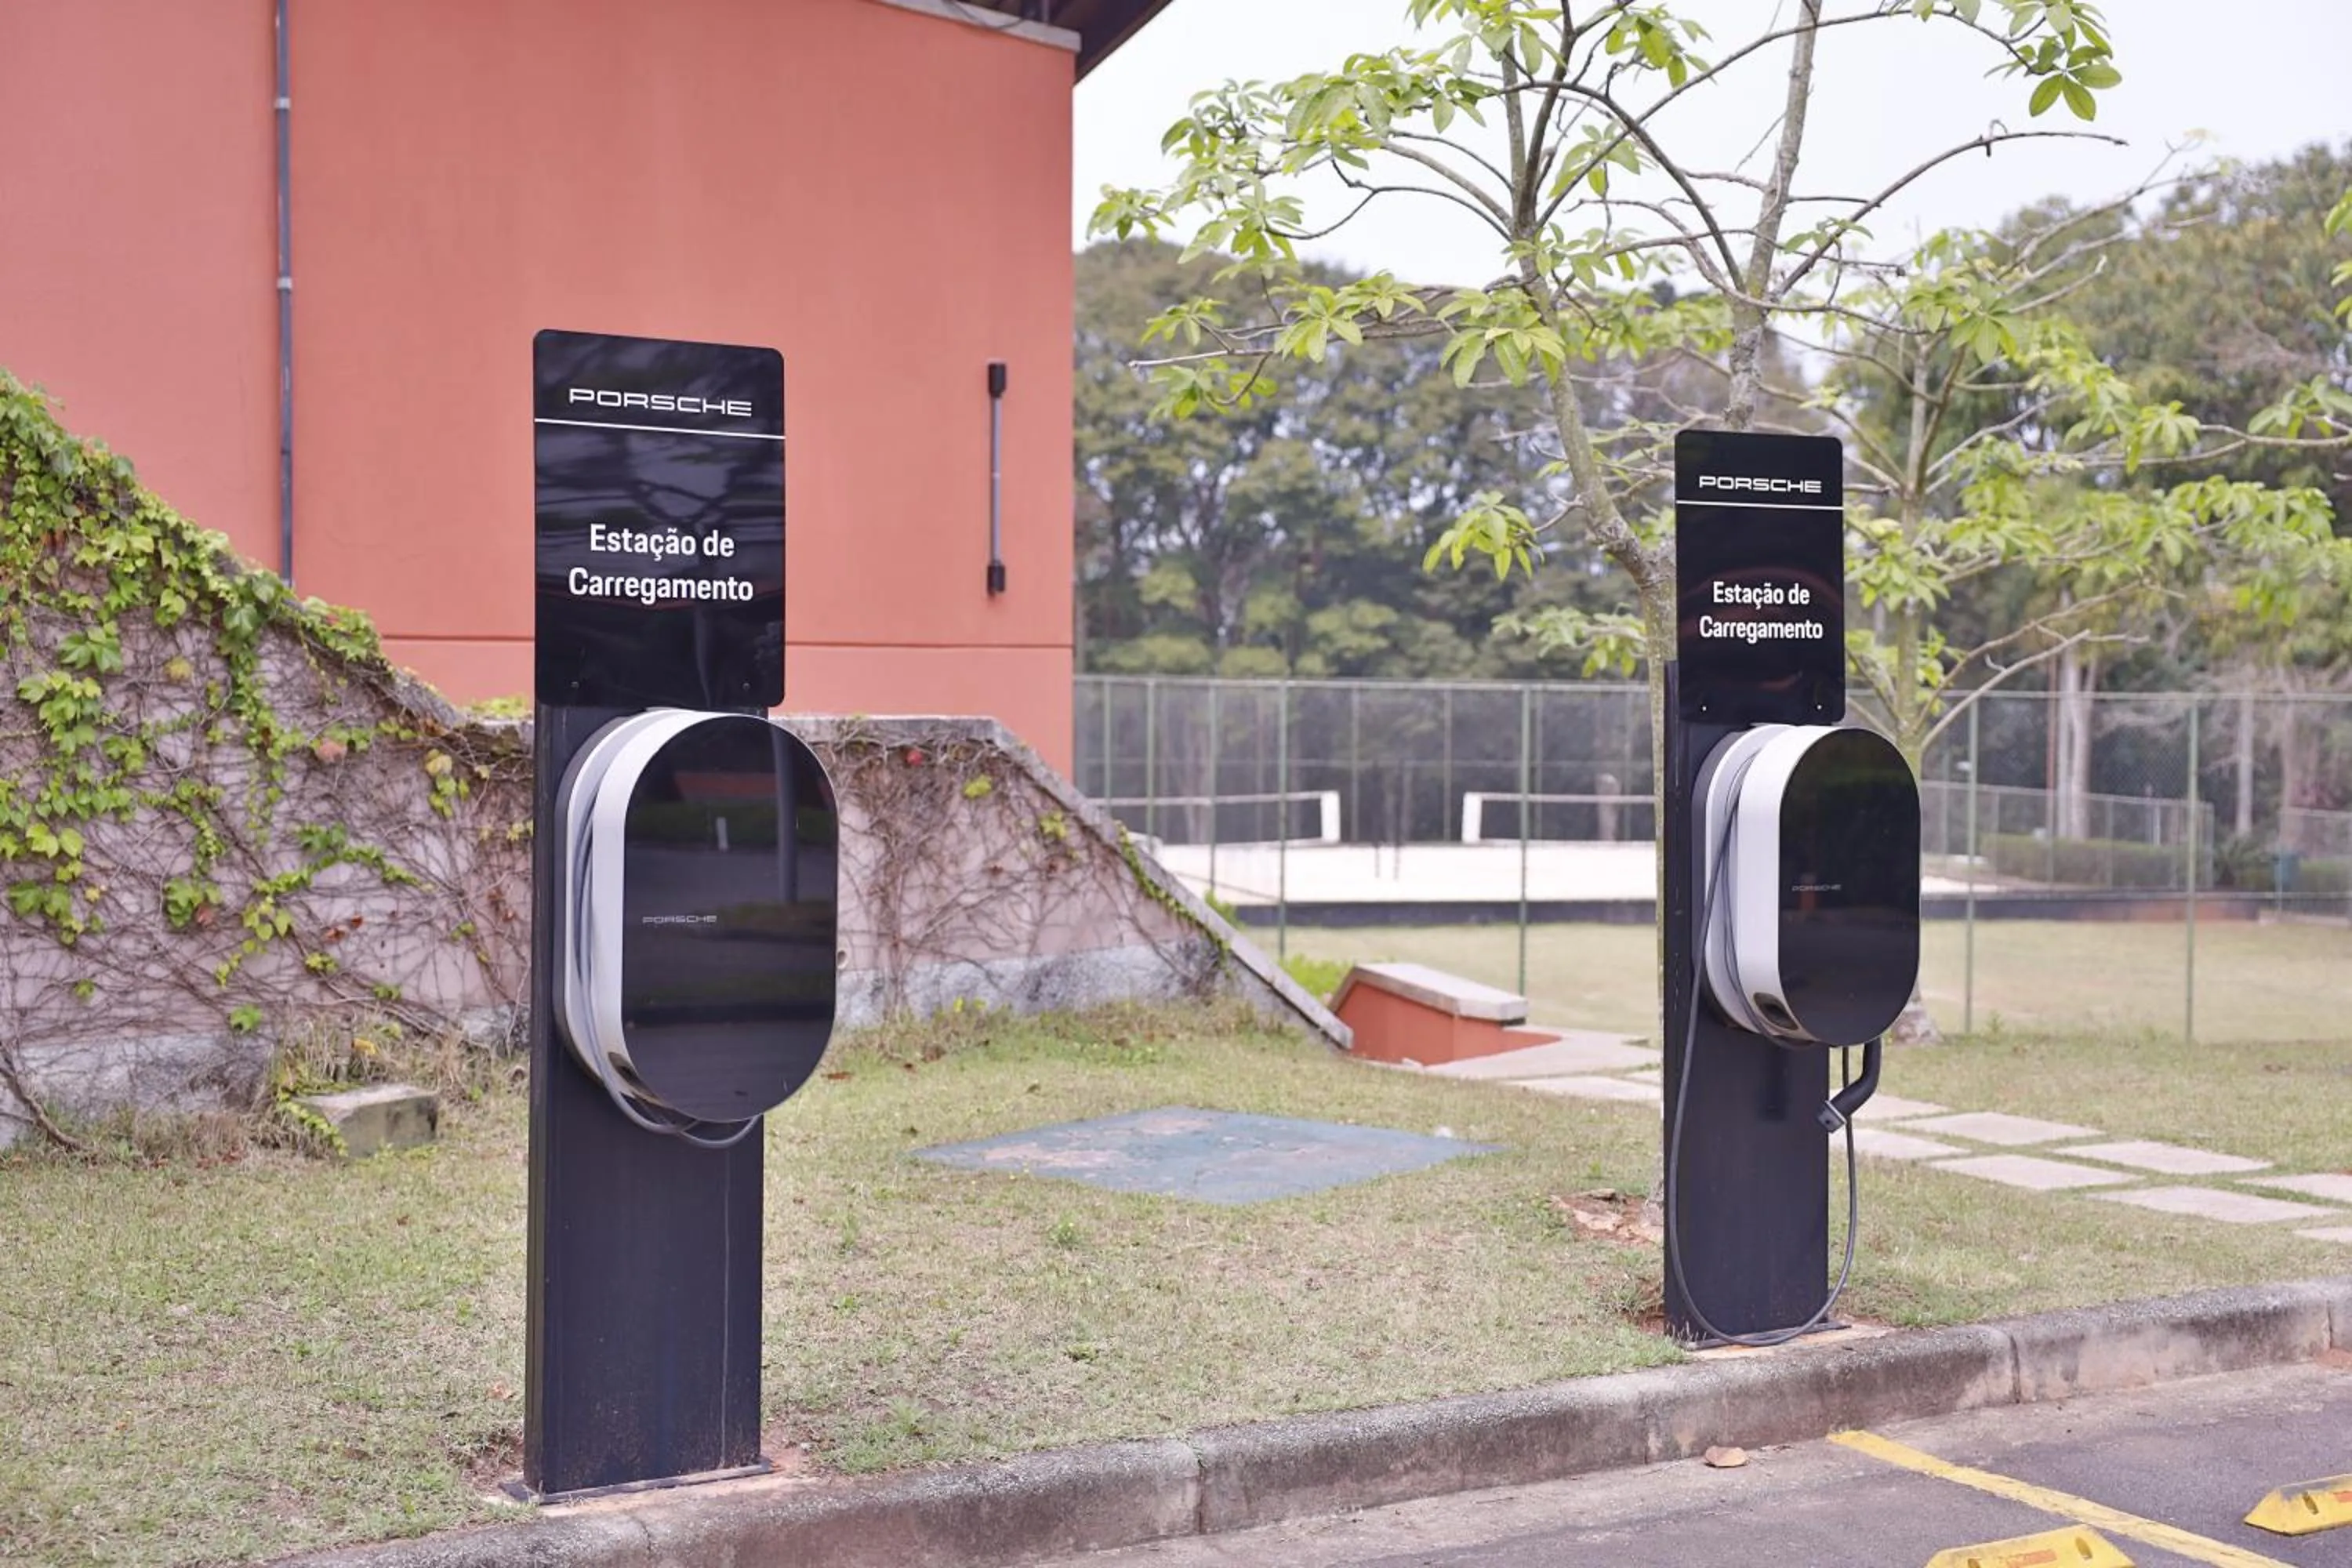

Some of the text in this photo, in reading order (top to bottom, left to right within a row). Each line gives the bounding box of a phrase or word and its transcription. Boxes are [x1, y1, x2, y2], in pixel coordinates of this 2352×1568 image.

[569, 388, 752, 417] PORSCHE
[1699, 475, 1821, 493] PORSCHE
[590, 523, 735, 561] Estação de
[568, 567, 753, 605] Carregamento
[1713, 581, 1810, 610] Estação de
[1699, 615, 1824, 644] Carregamento
[642, 915, 717, 924] PORSCHE
